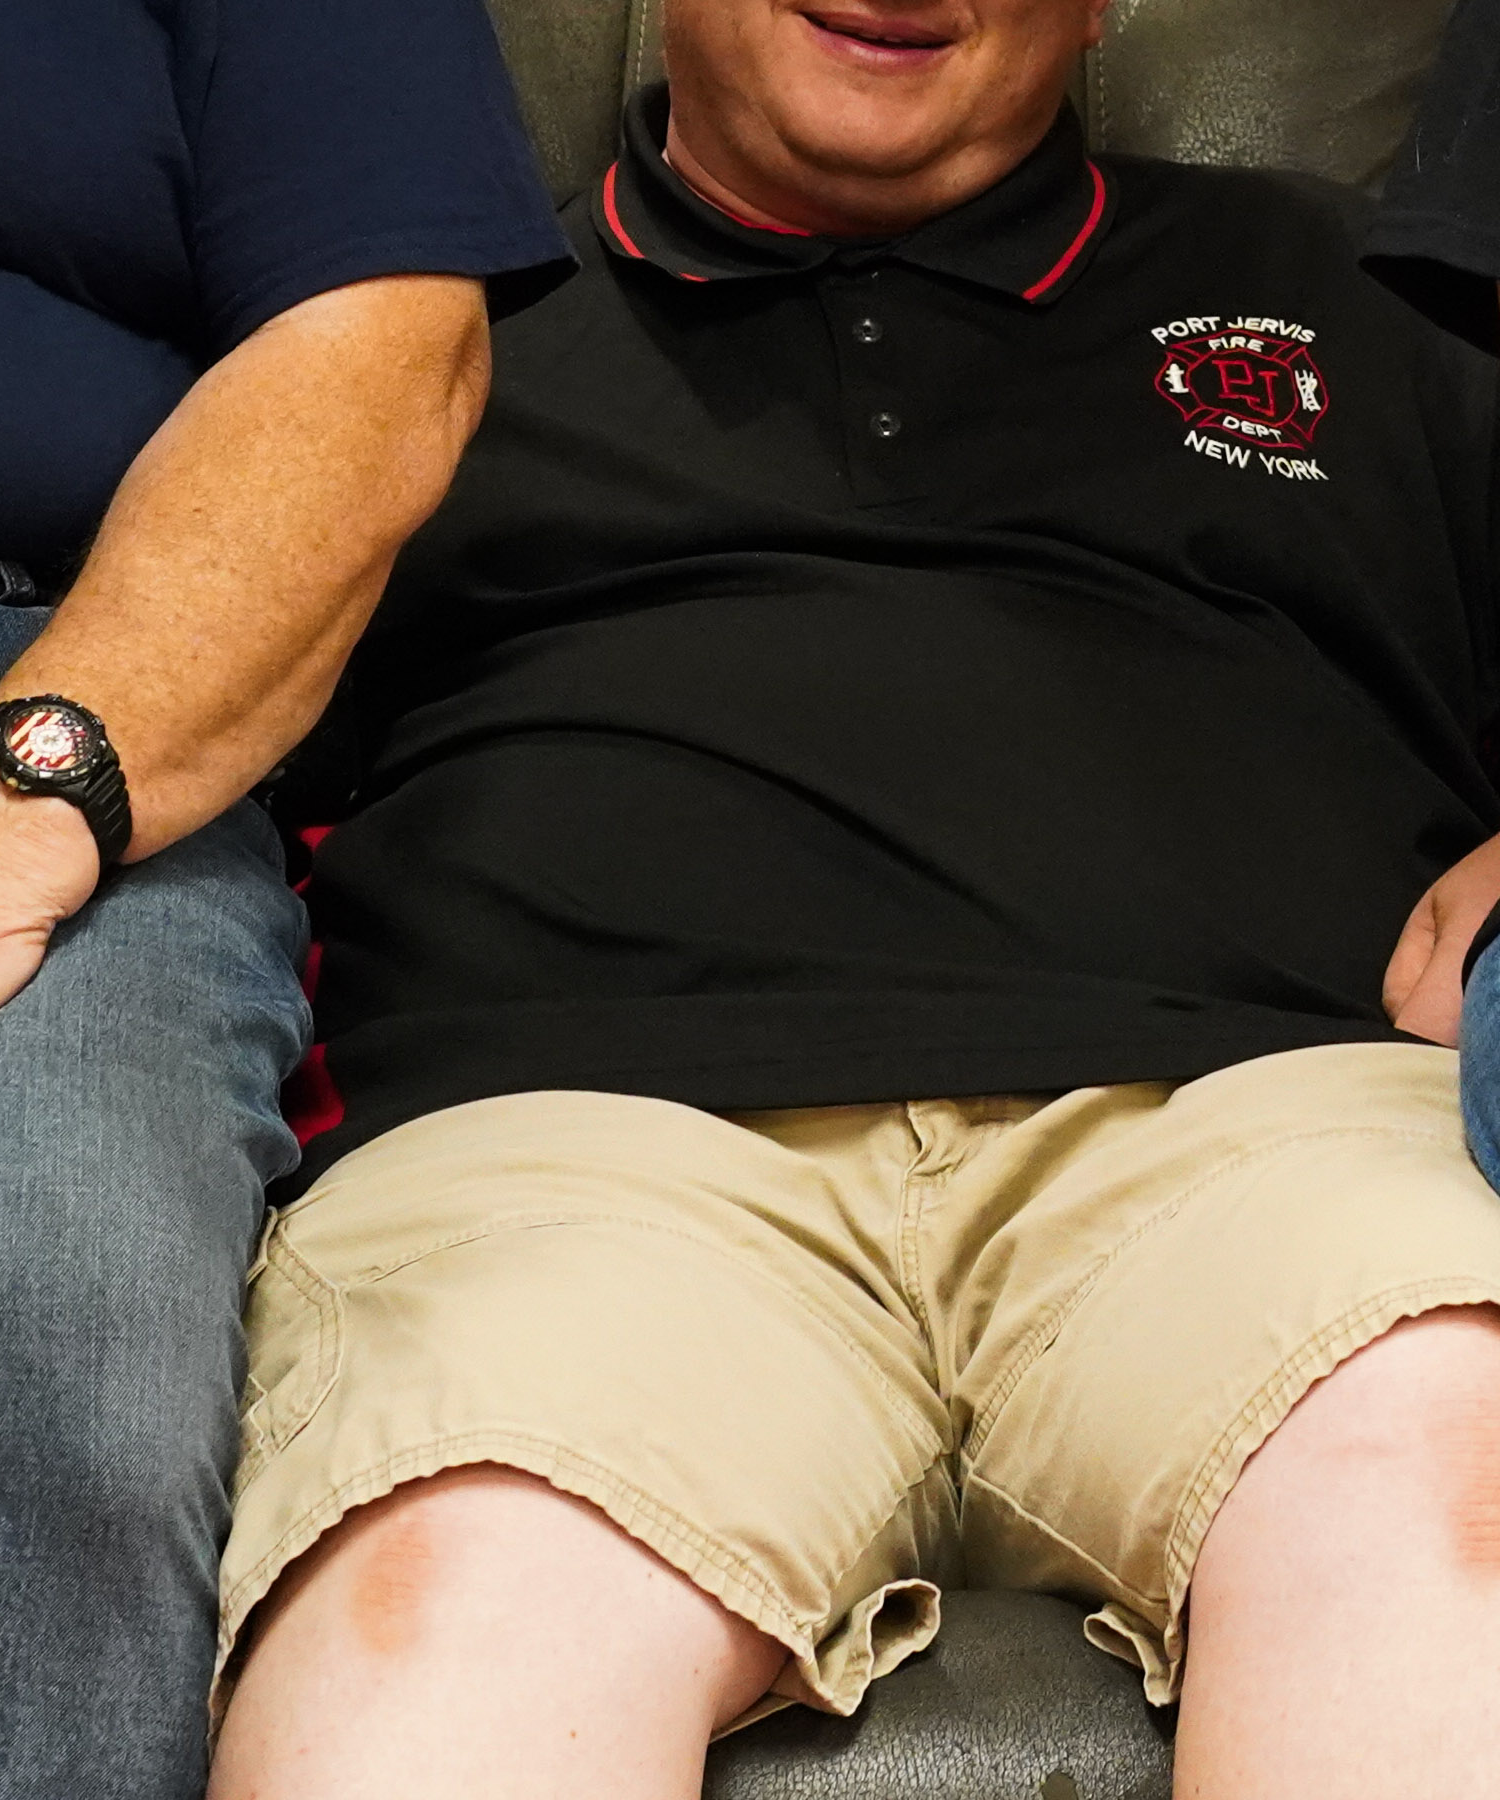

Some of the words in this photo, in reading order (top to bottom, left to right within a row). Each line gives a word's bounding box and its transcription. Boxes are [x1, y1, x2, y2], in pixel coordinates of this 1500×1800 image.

[1151, 315, 1221, 345] PORT
[1227, 315, 1316, 344] JERVIS
[1208, 336, 1265, 354] FIRE
[1222, 415, 1283, 444] DEPT
[1184, 429, 1251, 469] NEW
[1259, 452, 1330, 481] YORK
